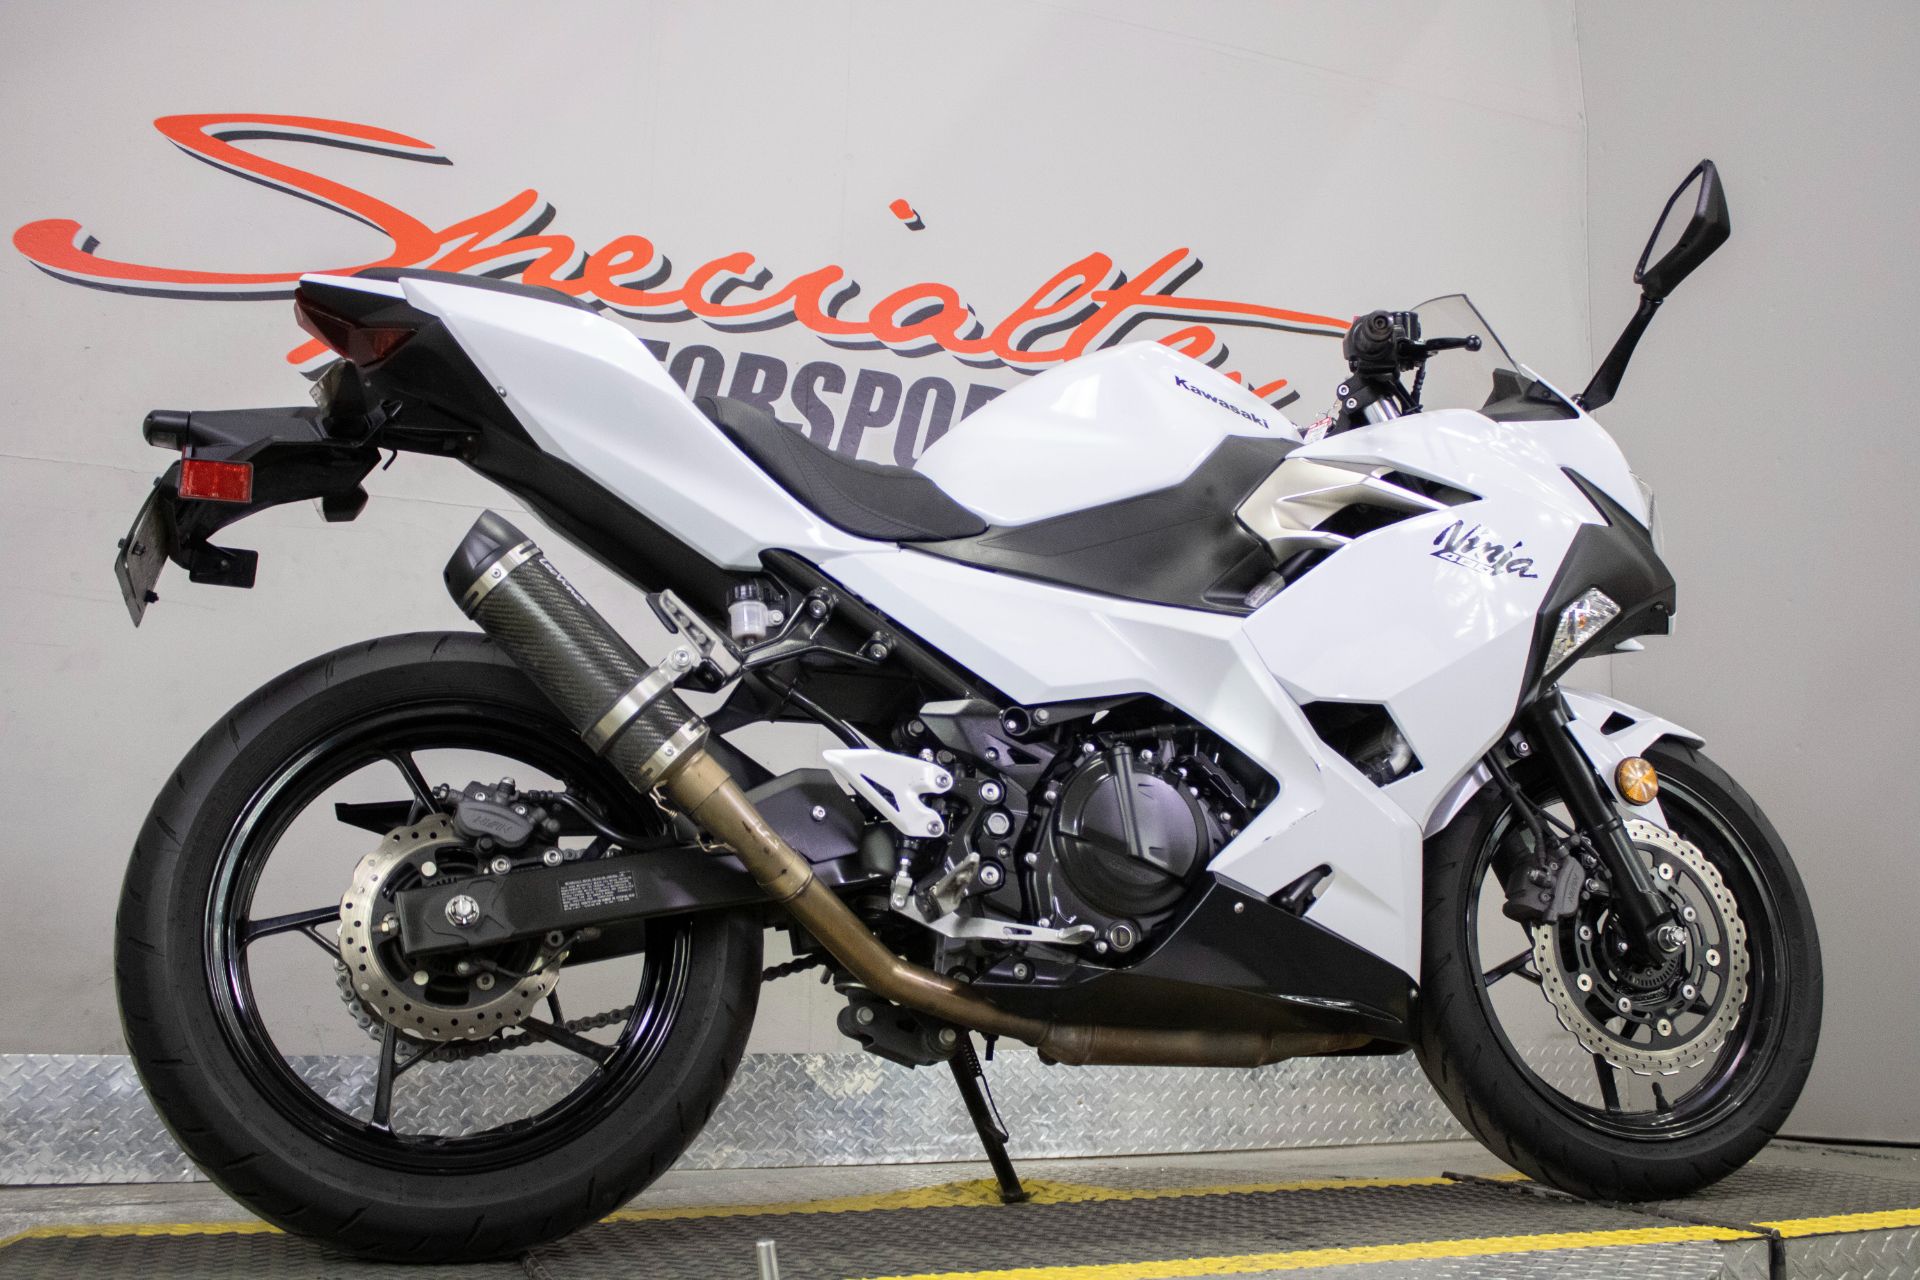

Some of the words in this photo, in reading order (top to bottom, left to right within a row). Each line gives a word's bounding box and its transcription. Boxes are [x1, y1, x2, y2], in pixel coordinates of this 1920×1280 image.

[636, 337, 1008, 470] ORSPO
[1174, 374, 1270, 430] Kawasaki
[1430, 519, 1539, 579] Ninja
